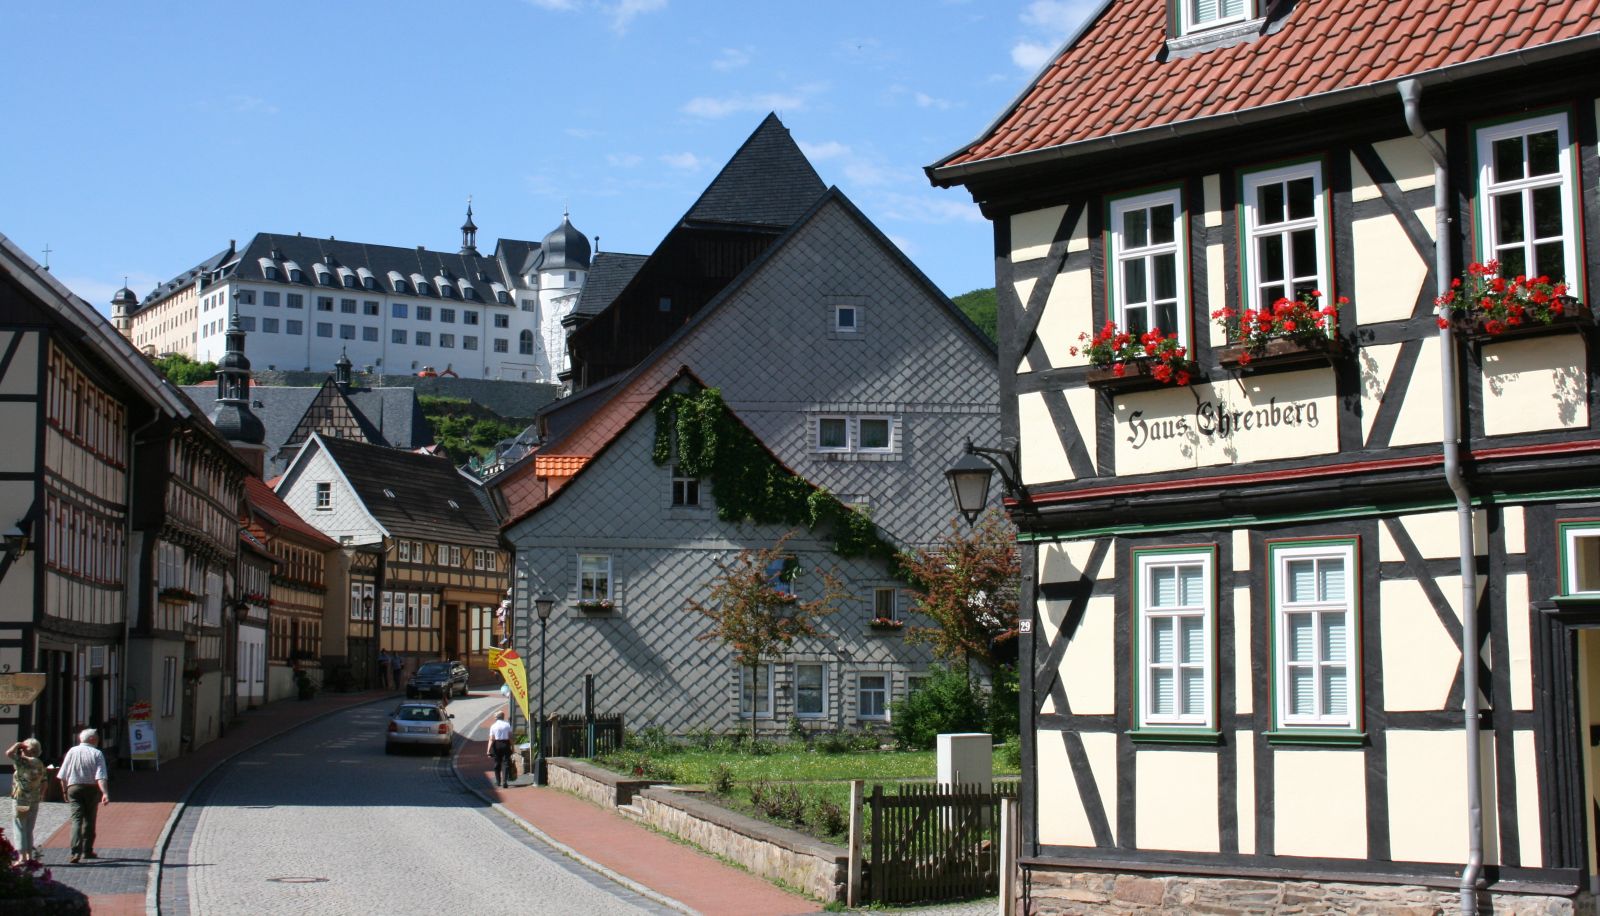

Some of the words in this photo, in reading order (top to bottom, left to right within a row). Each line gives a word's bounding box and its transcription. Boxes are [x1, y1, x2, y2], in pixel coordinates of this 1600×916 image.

[1126, 410, 1188, 449] Haus
[1195, 397, 1319, 438] Ehrenberg
[1020, 621, 1031, 632] 29
